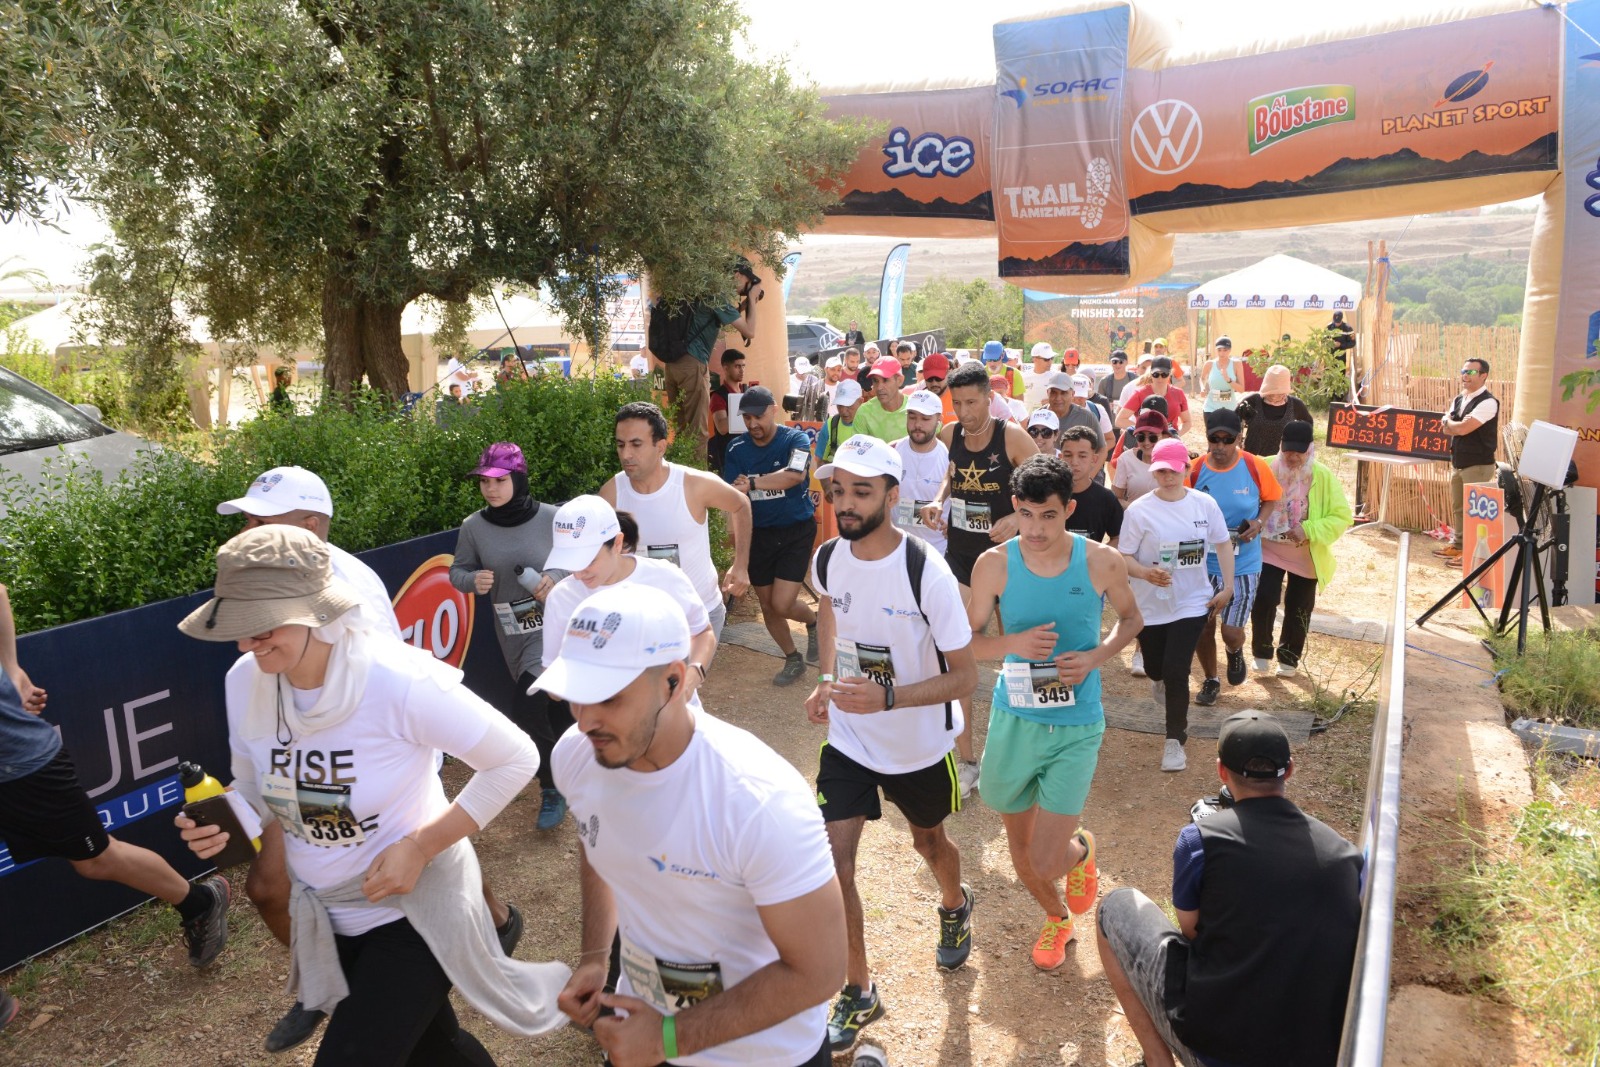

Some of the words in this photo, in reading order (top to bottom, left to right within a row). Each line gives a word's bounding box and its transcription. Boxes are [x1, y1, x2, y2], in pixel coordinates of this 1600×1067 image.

[1033, 77, 1119, 97] SOFAC
[1272, 95, 1287, 110] Al
[1255, 97, 1348, 145] Boustane
[1382, 108, 1468, 135] PLANET
[1473, 96, 1551, 123] SPORT
[884, 128, 974, 177] ice
[1004, 182, 1084, 218] TRAIL
[1020, 206, 1081, 218] AMIZMIZ
[1071, 308, 1115, 318] FINISHER
[1116, 308, 1145, 318] 2022
[1468, 490, 1498, 520] ice
[968, 517, 990, 530] 330
[520, 614, 544, 631] 269
[1037, 686, 1070, 704] 345
[271, 748, 357, 784] RISE
[307, 818, 357, 841] 338
